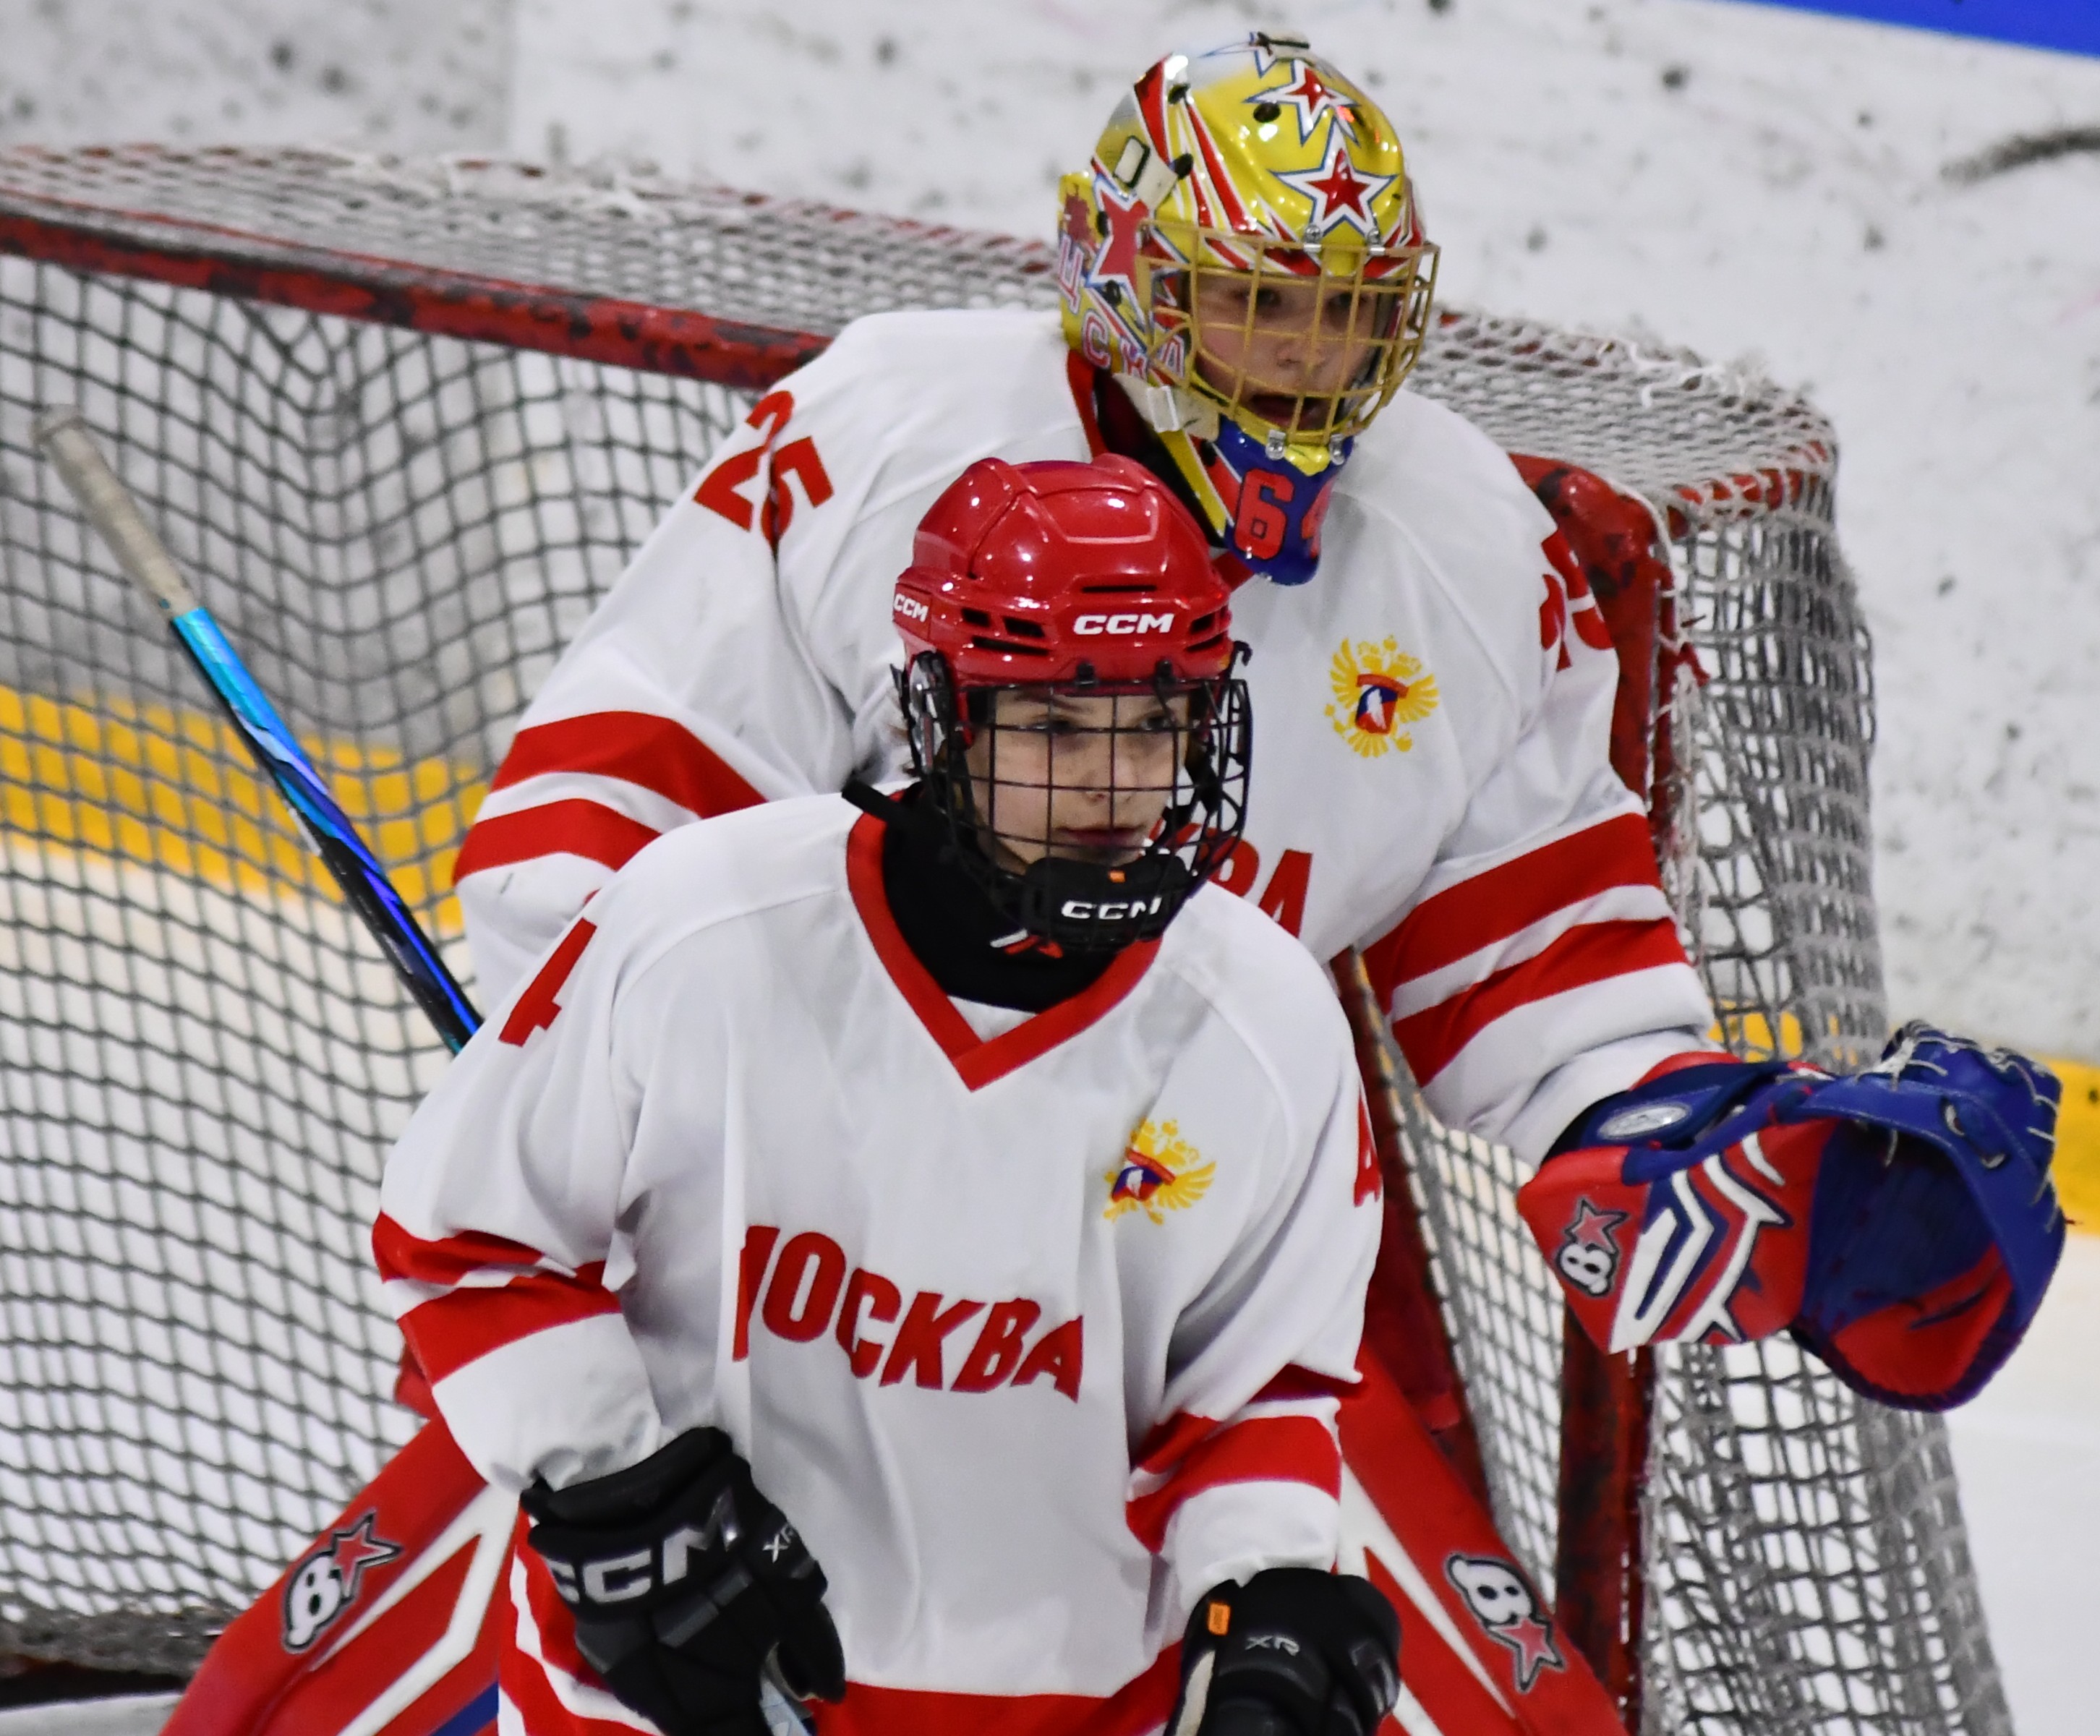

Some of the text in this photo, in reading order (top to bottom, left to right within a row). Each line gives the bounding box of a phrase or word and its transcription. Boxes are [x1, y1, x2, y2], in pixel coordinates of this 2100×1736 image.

[692, 390, 835, 555] 25
[892, 593, 929, 623] CCM
[1073, 613, 1175, 636] CCM
